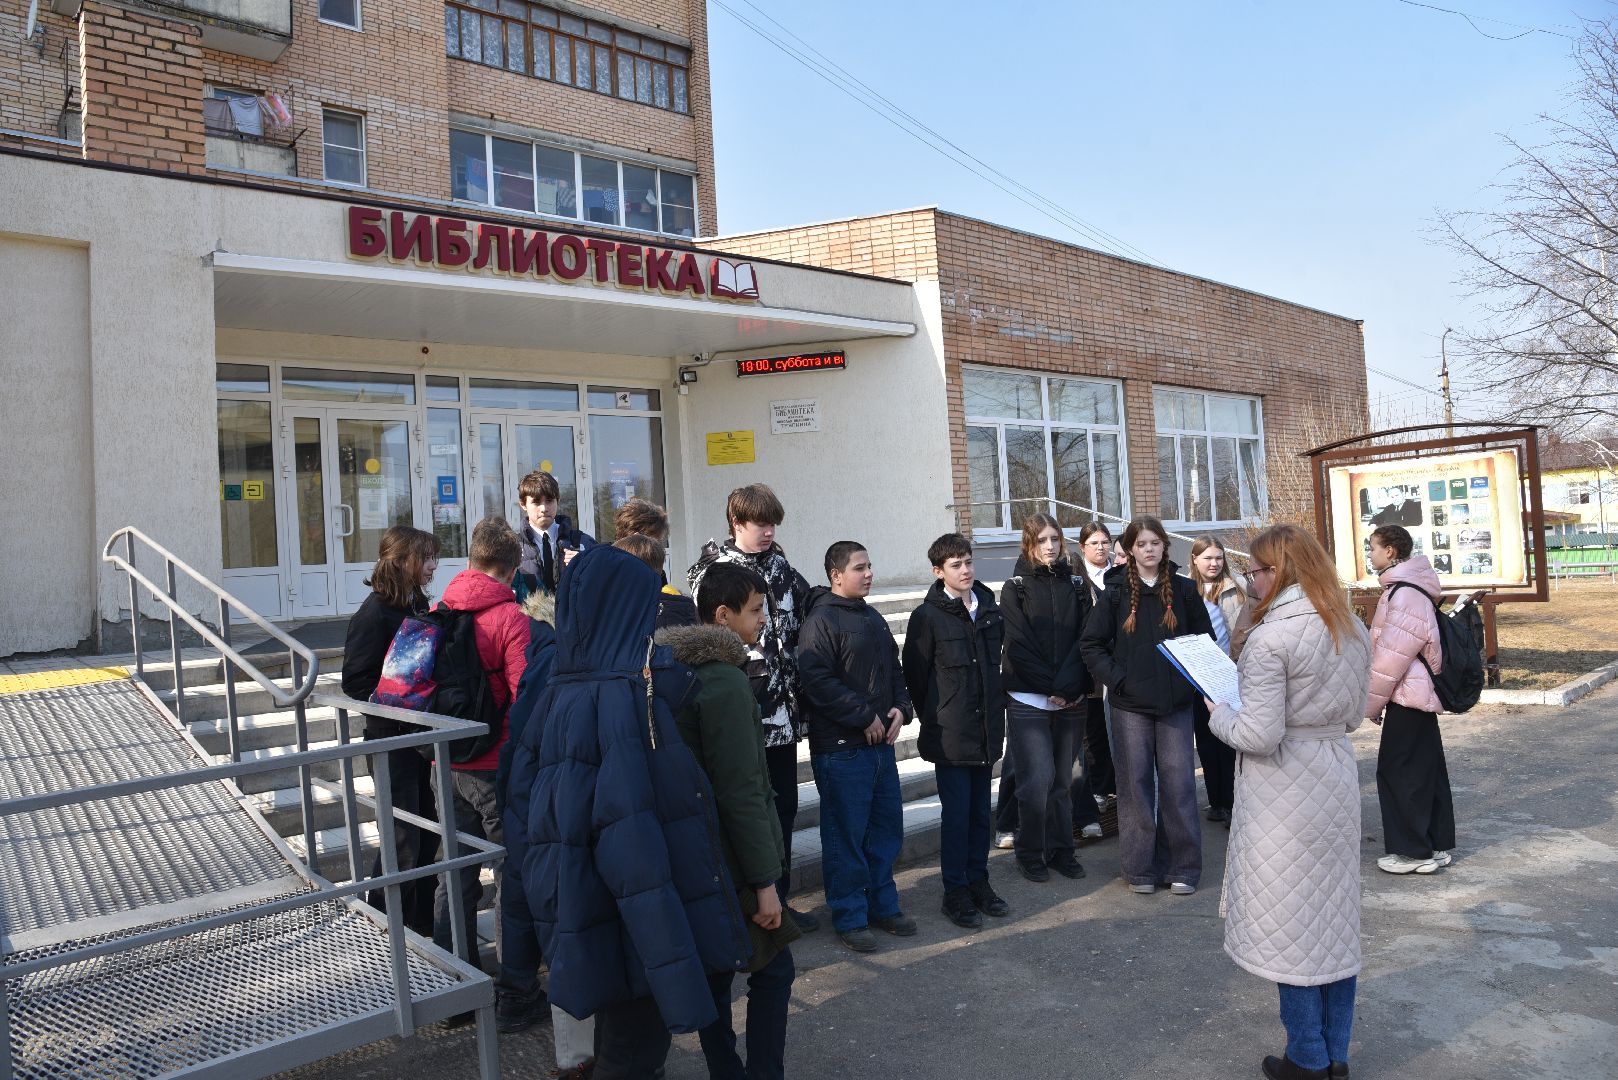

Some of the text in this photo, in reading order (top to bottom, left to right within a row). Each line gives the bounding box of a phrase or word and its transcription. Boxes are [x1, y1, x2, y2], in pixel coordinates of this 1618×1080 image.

[348, 206, 706, 296] БИБЛИОТЕКА
[775, 357, 821, 371] суббота
[824, 356, 832, 365] и
